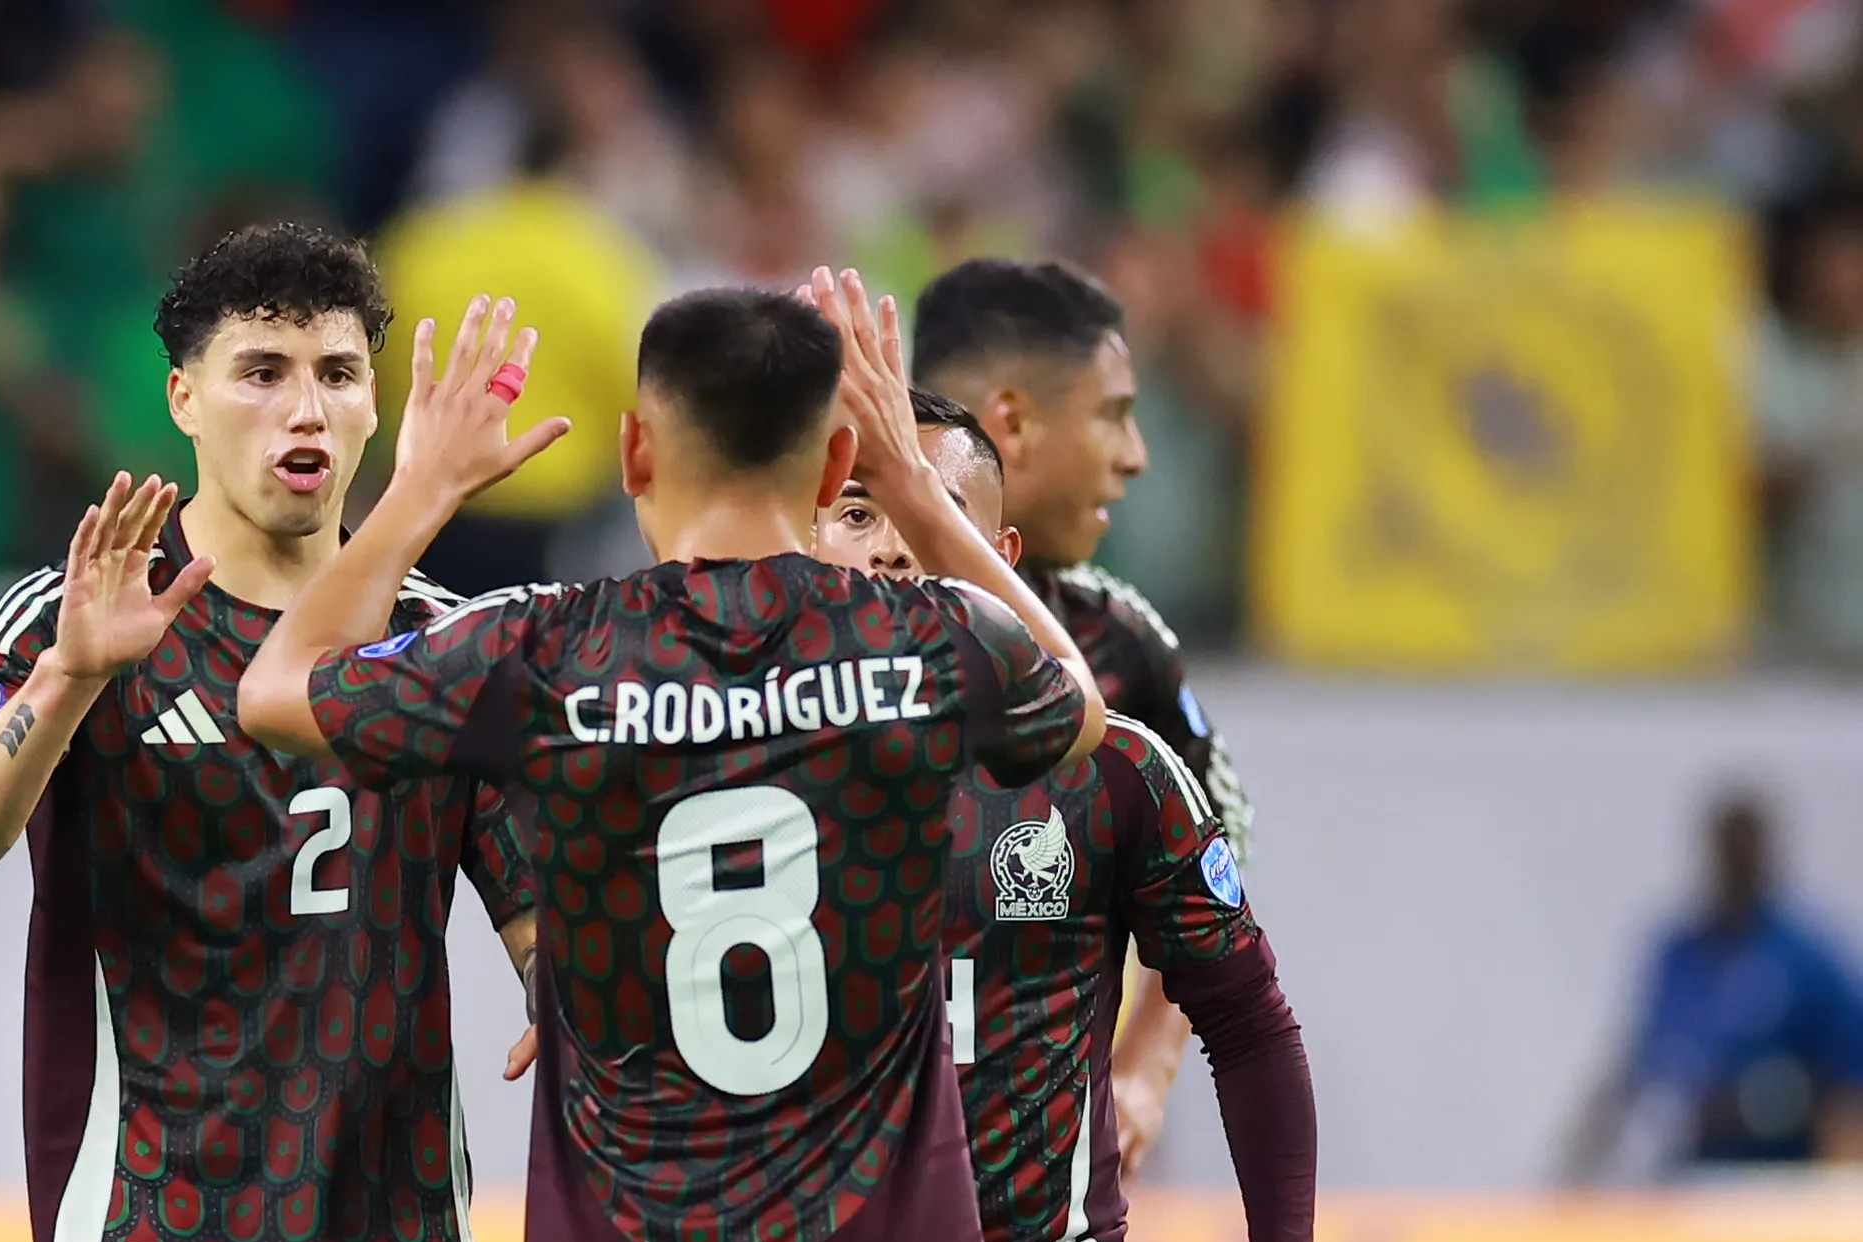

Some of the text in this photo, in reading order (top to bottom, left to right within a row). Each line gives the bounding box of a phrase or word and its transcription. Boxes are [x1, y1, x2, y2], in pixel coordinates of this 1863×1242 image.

[565, 655, 931, 745] C.RODRÍGUEZ
[287, 786, 351, 915] 2
[657, 785, 829, 1097] 8
[999, 898, 1065, 917] MÉXICO
